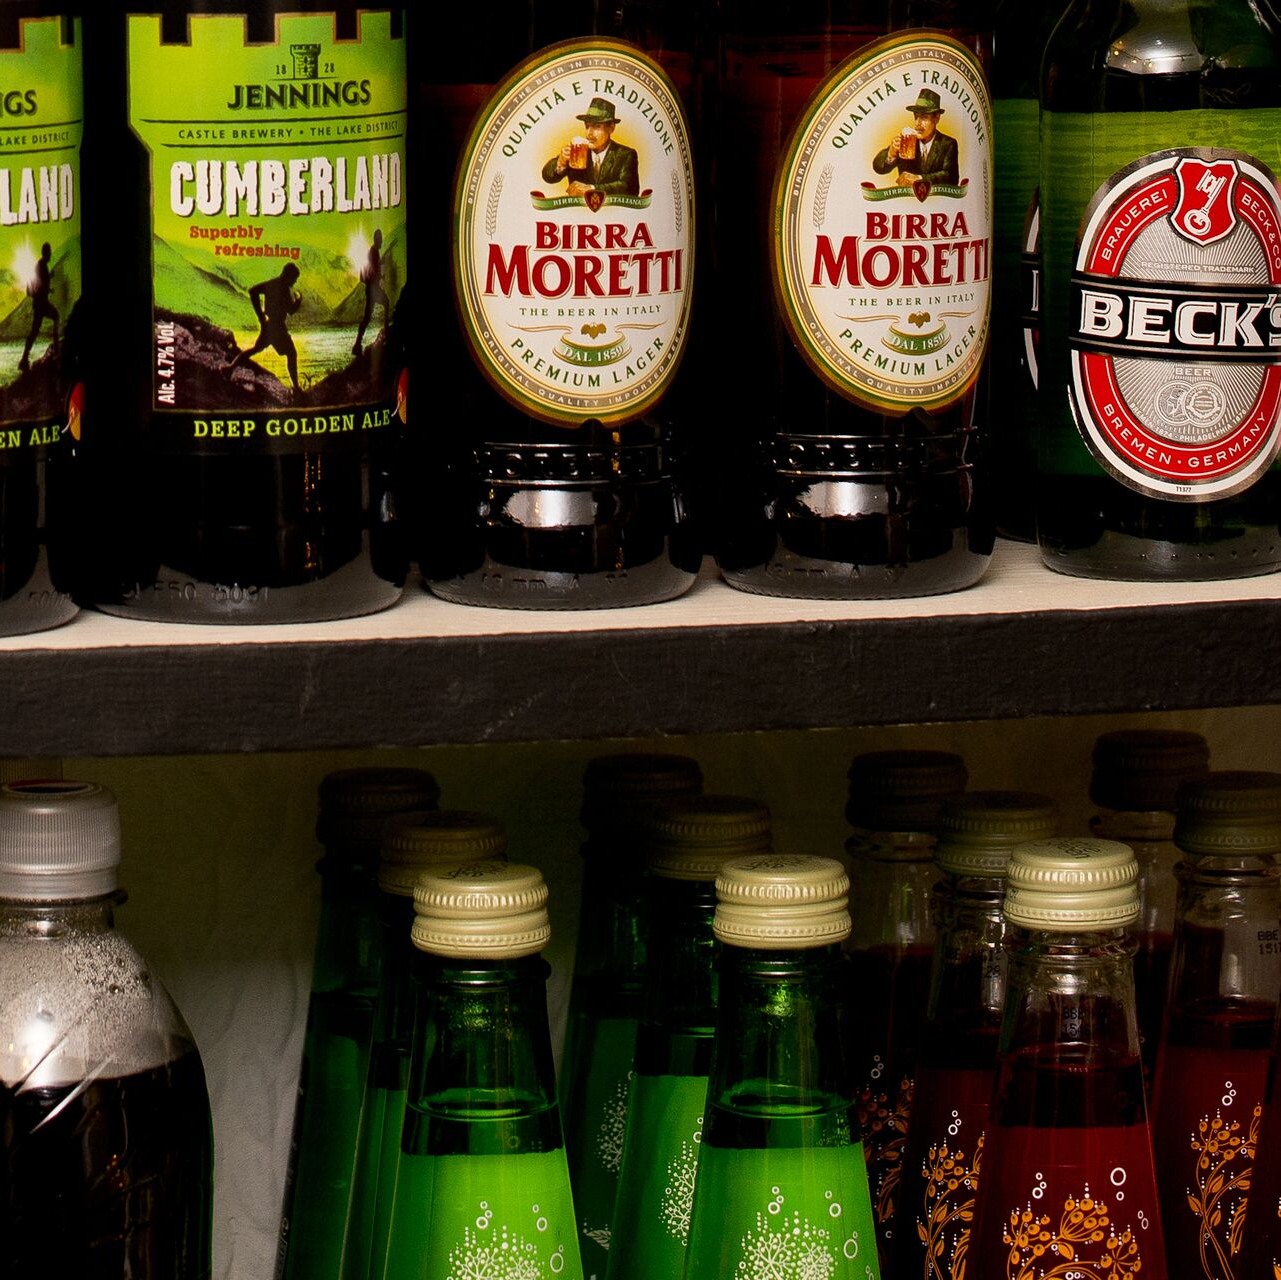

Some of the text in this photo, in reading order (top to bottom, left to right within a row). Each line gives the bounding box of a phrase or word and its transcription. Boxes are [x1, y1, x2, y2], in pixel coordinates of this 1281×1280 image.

[226, 78, 372, 111] JENNINGS
[571, 80, 584, 97] E
[592, 77, 675, 158] TRADIZIONE
[30, 130, 71, 144] DISTRICT
[169, 151, 403, 218] CUMBERLAND
[189, 224, 264, 242] Superbly
[534, 220, 654, 251] BIRRA
[865, 211, 970, 241] BIRRA
[1100, 187, 1168, 262] BRAUEREI
[214, 242, 301, 260] refreshing
[810, 233, 989, 289] MORETTI
[482, 242, 686, 299] MORETTI
[519, 303, 663, 317] THE BEER IN ITALY
[509, 335, 665, 389] PREMIUM LAGER
[838, 323, 978, 377] PREMIUM LAGER
[1174, 367, 1213, 377] BEER
[29, 425, 62, 446] ALE
[1103, 402, 1267, 470] BREMEN GERMANY
